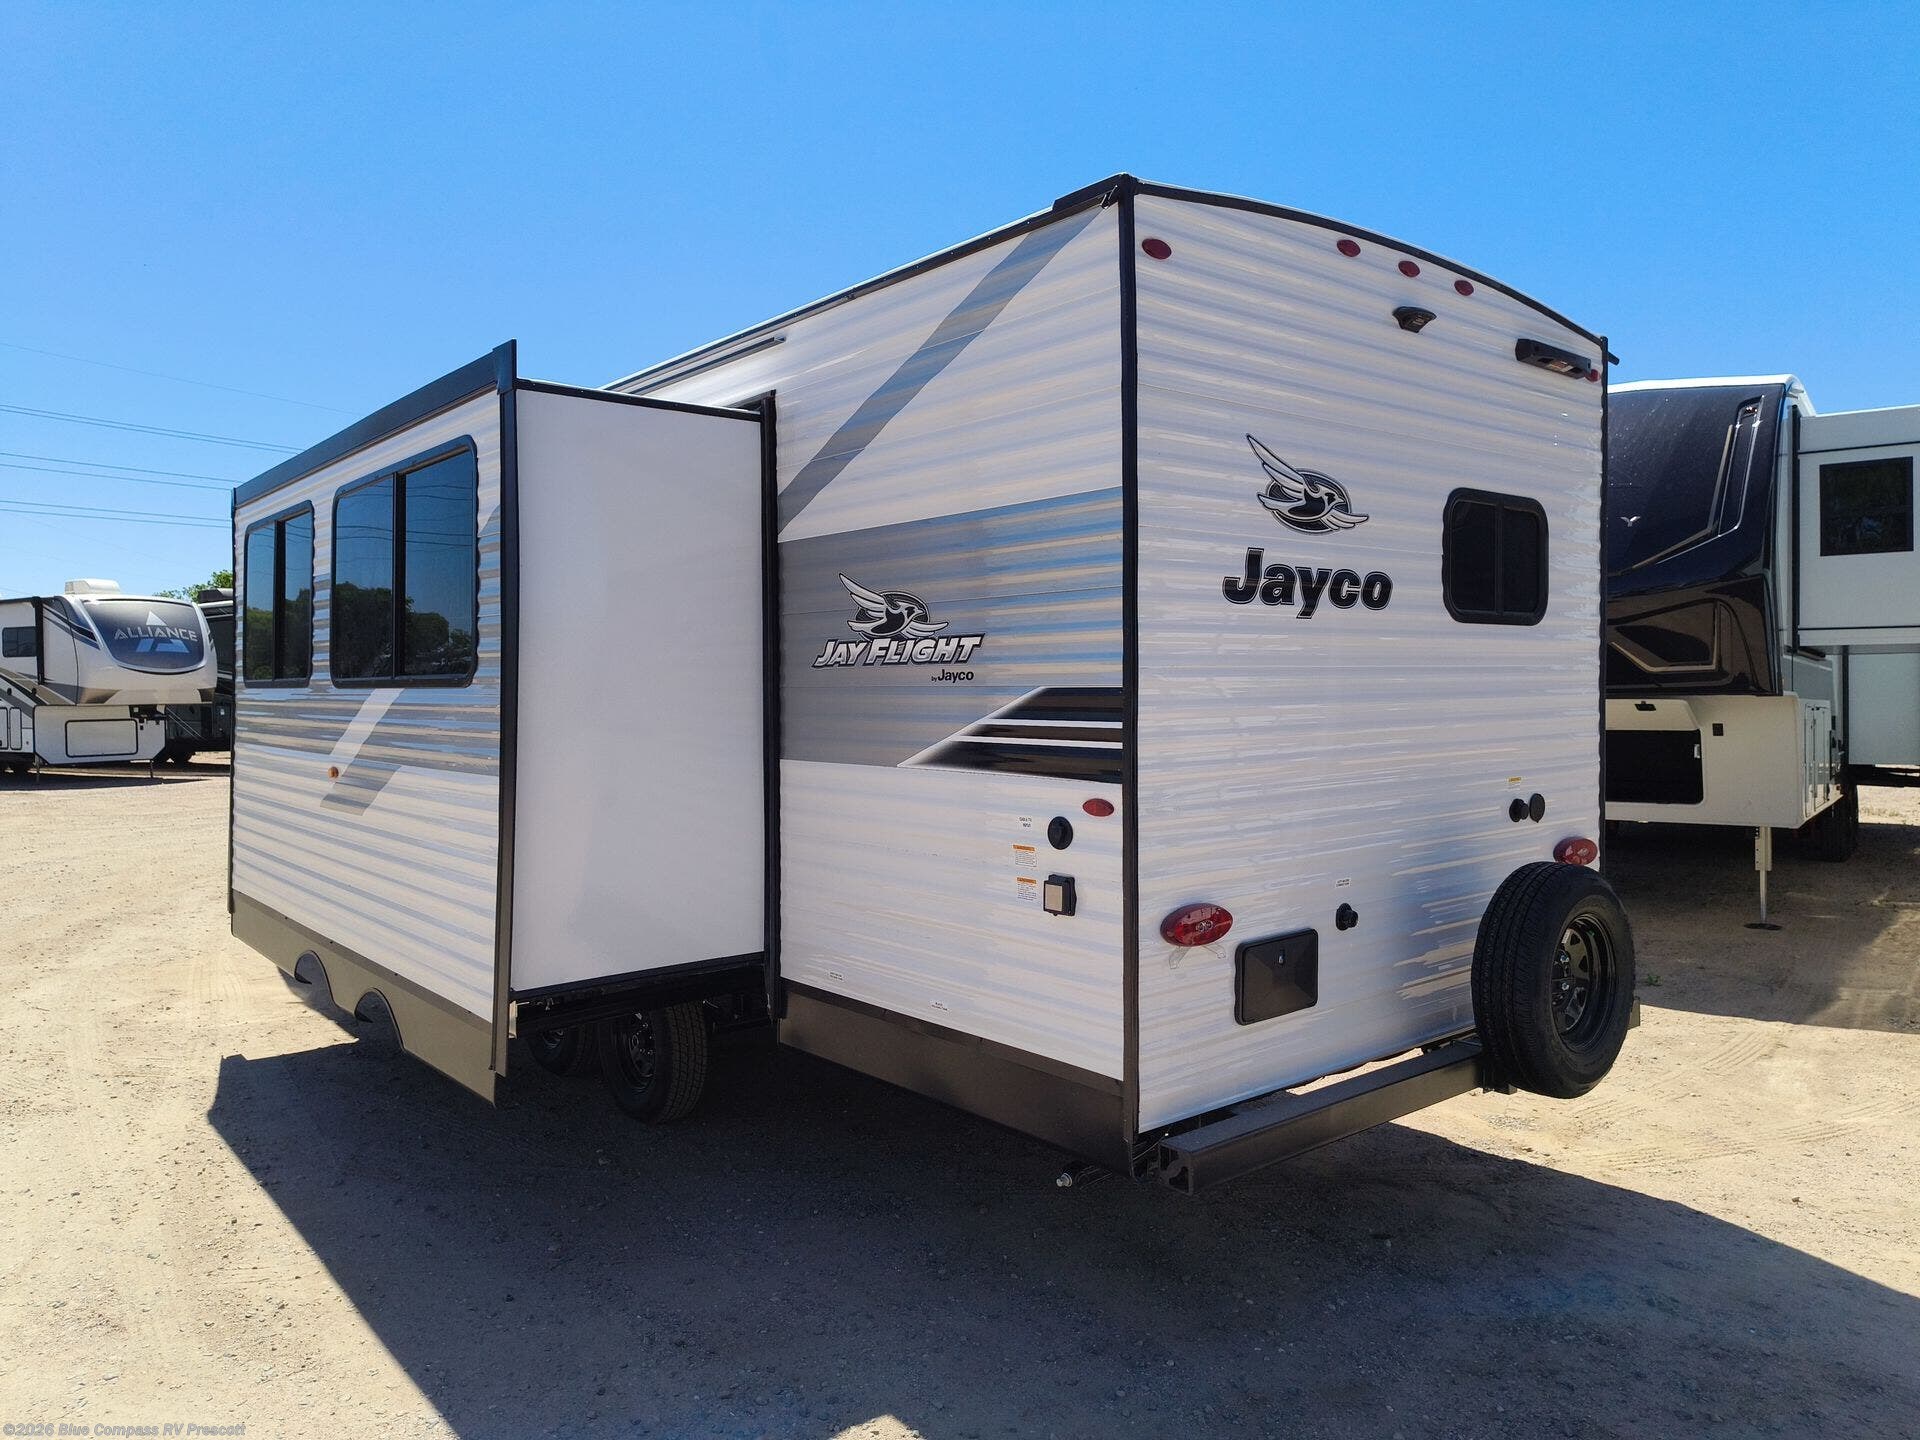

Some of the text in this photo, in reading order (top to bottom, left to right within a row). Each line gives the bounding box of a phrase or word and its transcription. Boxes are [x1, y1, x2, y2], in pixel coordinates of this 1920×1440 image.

[1222, 547, 1393, 619] Jayco
[114, 627, 198, 642] ALLIANCE
[812, 633, 985, 668] JAY FLIGHT
[938, 669, 974, 683] Jayco
